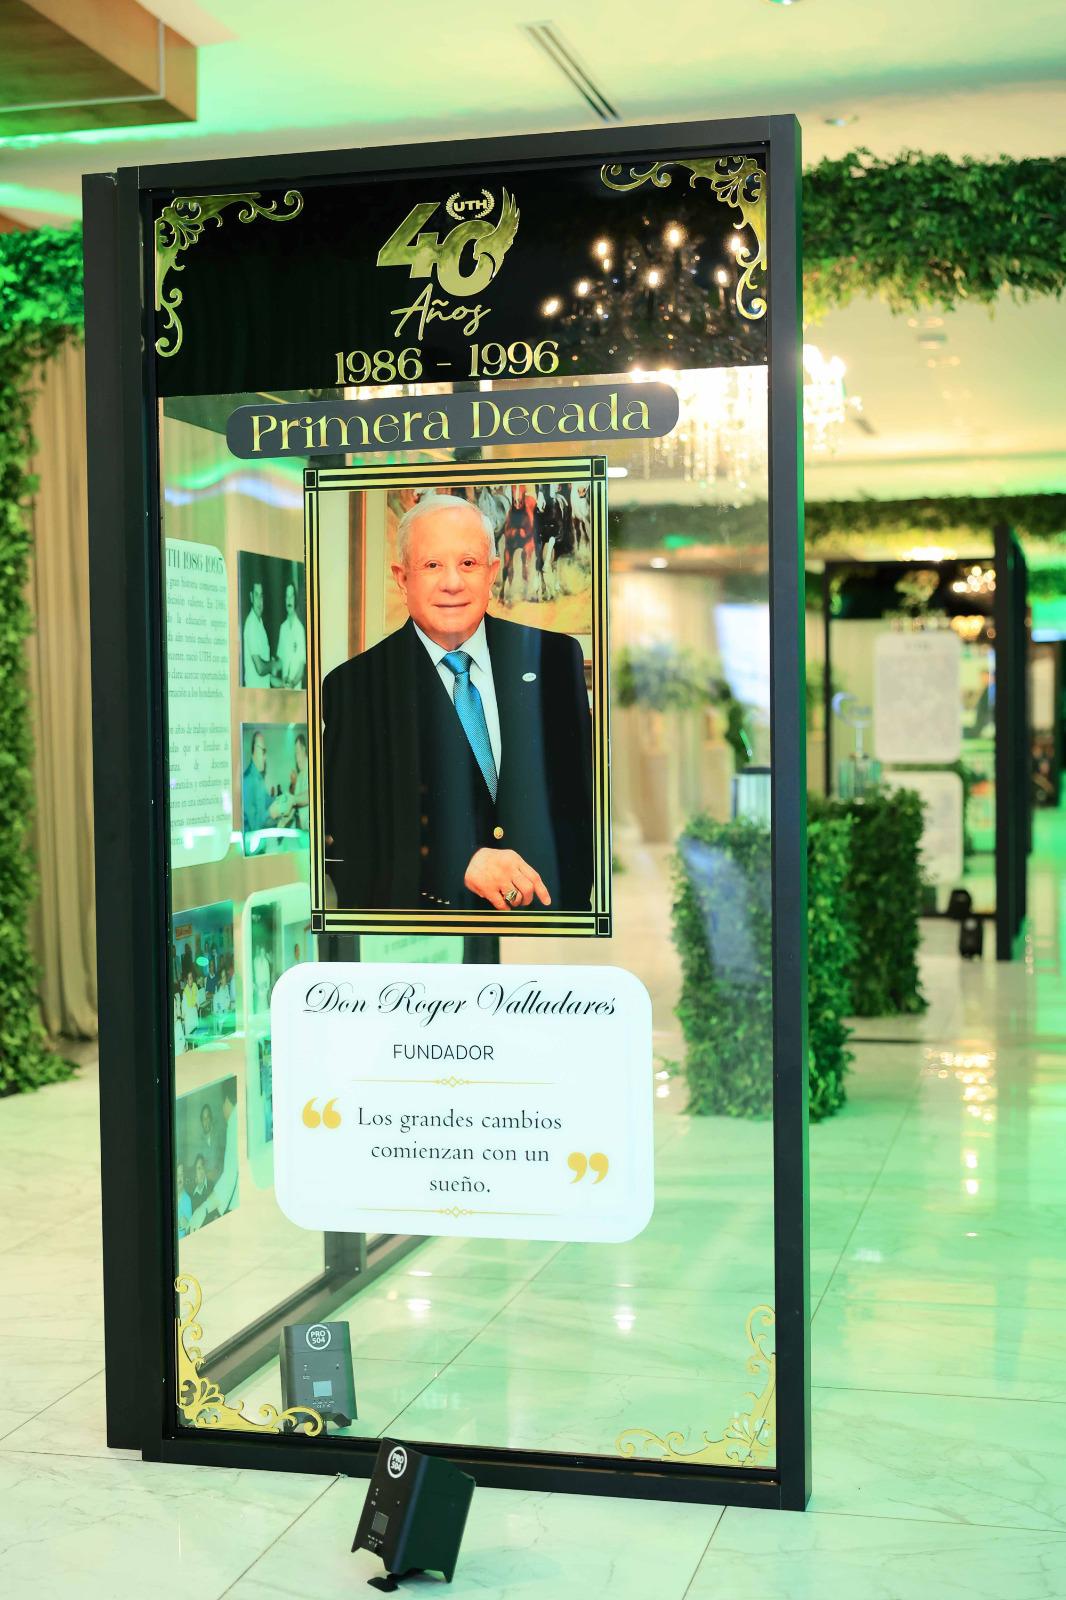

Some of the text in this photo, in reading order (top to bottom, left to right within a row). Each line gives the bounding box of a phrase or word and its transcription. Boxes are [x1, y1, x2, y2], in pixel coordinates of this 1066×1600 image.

[453, 199, 488, 212] UTH
[376, 198, 510, 297] 40
[390, 283, 492, 341] Años
[334, 347, 423, 385] 1986
[468, 340, 559, 377] 1996
[250, 393, 651, 452] Primera Decada
[303, 980, 616, 1027] Don Roger Valladares
[393, 1044, 494, 1060] FUNDADOR
[358, 1107, 562, 1133] Los grandes cambios
[371, 1141, 549, 1162] comienzan con un
[429, 1176, 491, 1193] sueño.
[310, 1330, 326, 1338] PRO
[390, 1461, 402, 1471] 504
[392, 1453, 404, 1464] PRO
